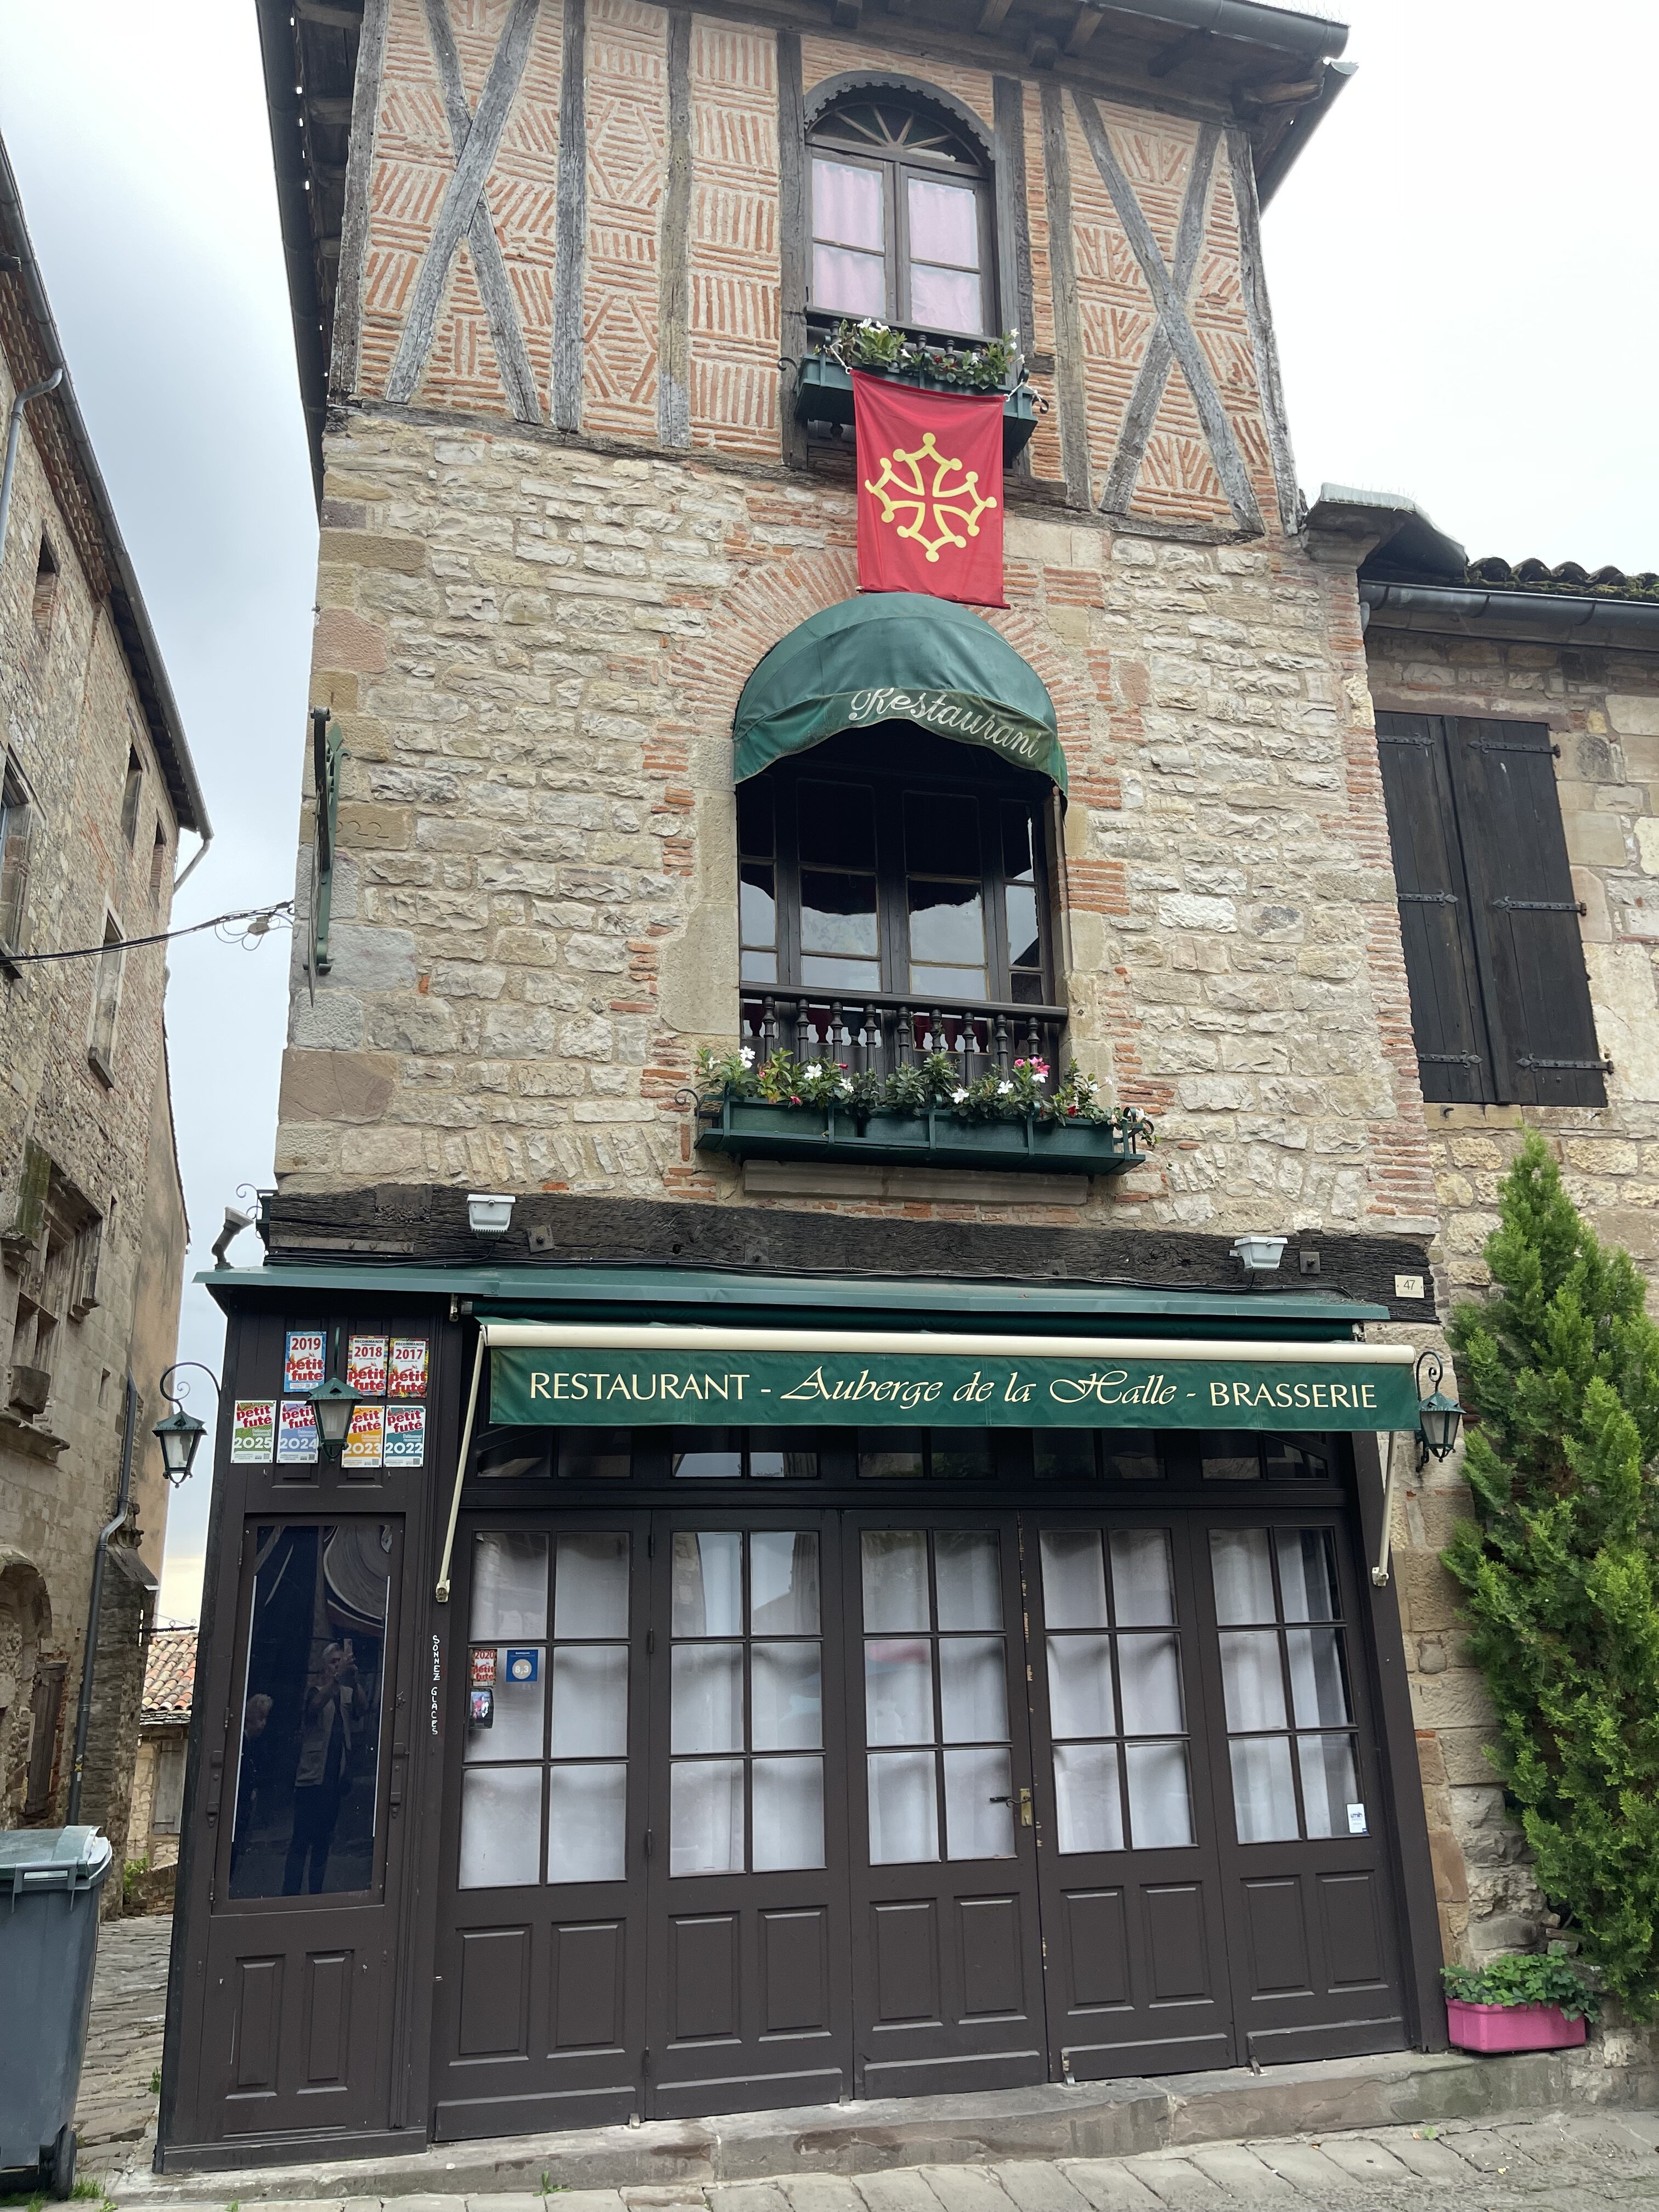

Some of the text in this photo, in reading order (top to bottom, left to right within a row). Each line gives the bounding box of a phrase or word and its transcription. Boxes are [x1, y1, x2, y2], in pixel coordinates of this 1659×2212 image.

[848, 687, 1042, 759] Restaurant
[1403, 1279, 1415, 1290] 47
[291, 1338, 321, 1350] 2019
[354, 1346, 382, 1357] 2018
[395, 1348, 424, 1359] 2017
[286, 1359, 324, 1373] petit
[348, 1368, 386, 1381] petit
[389, 1370, 426, 1384] petit
[531, 1373, 750, 1400] RESTAURANT
[780, 1365, 944, 1409] Auberge
[953, 1371, 995, 1402] de
[1004, 1372, 1037, 1402] la
[1049, 1370, 1177, 1404] Halle
[1210, 1383, 1377, 1408] BRASSERIE
[236, 1404, 271, 1421] petit
[387, 1410, 421, 1426] petit
[243, 1415, 272, 1428] futé
[289, 1417, 316, 1429] futé
[352, 1420, 381, 1433] futé
[394, 1420, 422, 1433] futé
[234, 1437, 272, 1448] 2025
[280, 1438, 317, 1449] 2024
[345, 1442, 382, 1454] 2023
[386, 1442, 423, 1454] 2022
[432, 1635, 441, 1681] SONNEZ
[475, 1651, 494, 1660] 2020
[472, 1666, 494, 1674] petit
[515, 1666, 529, 1674] 8,3
